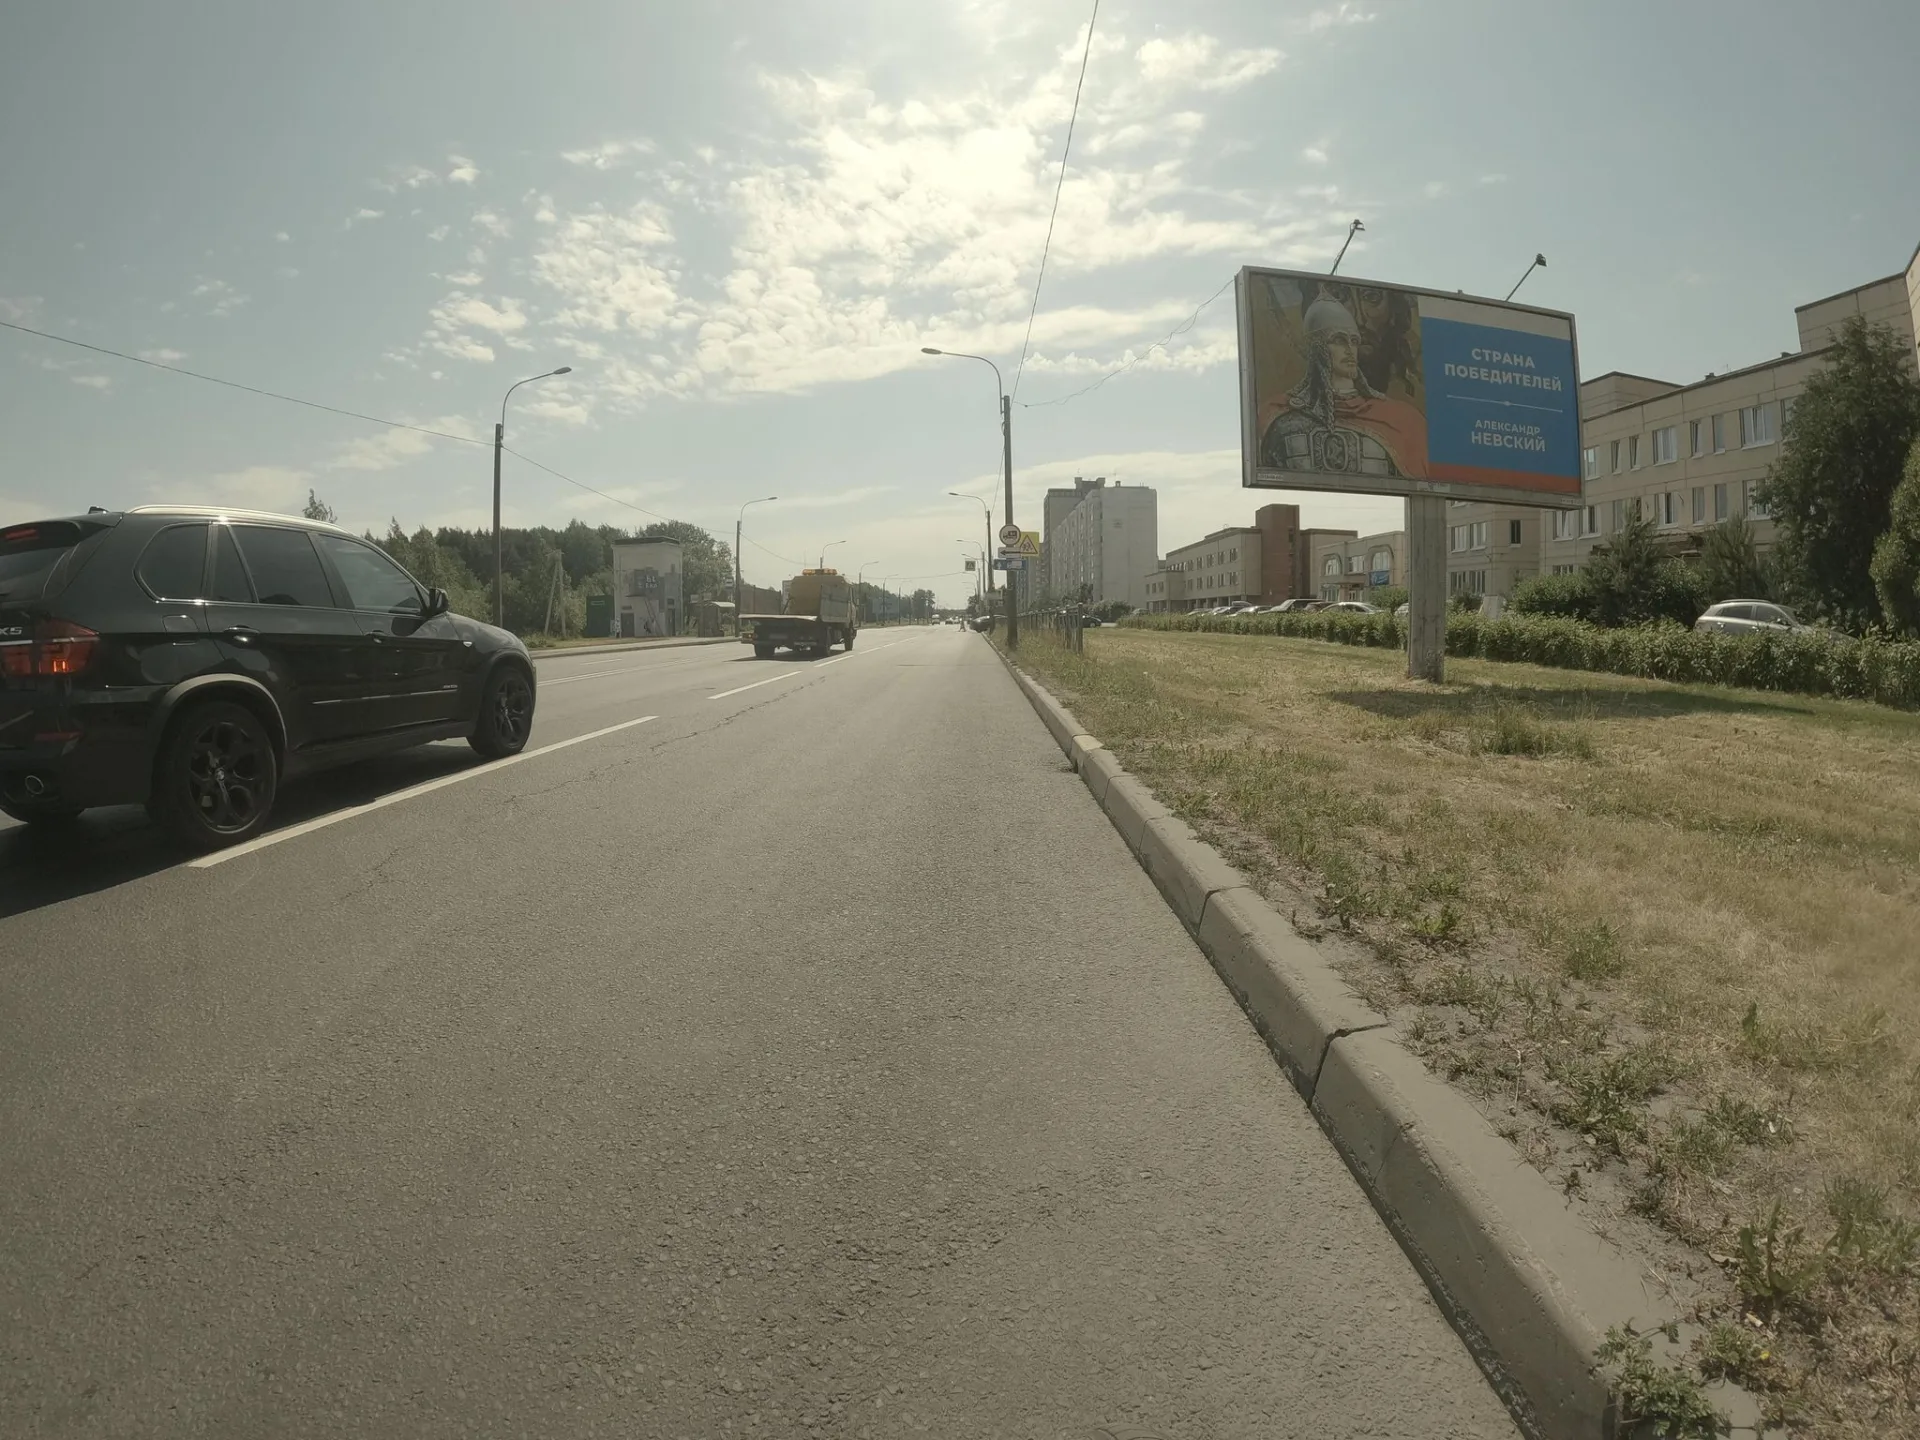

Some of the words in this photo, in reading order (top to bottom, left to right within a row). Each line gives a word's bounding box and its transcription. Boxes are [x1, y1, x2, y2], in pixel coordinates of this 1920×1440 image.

[1471, 348, 1535, 368] СТРАНА
[1444, 363, 1562, 391] ПОБЕДИТЕЛЕЙ
[1475, 419, 1540, 436] АЛЕКСАНДР
[1471, 431, 1546, 452] НЕВСКИЙ
